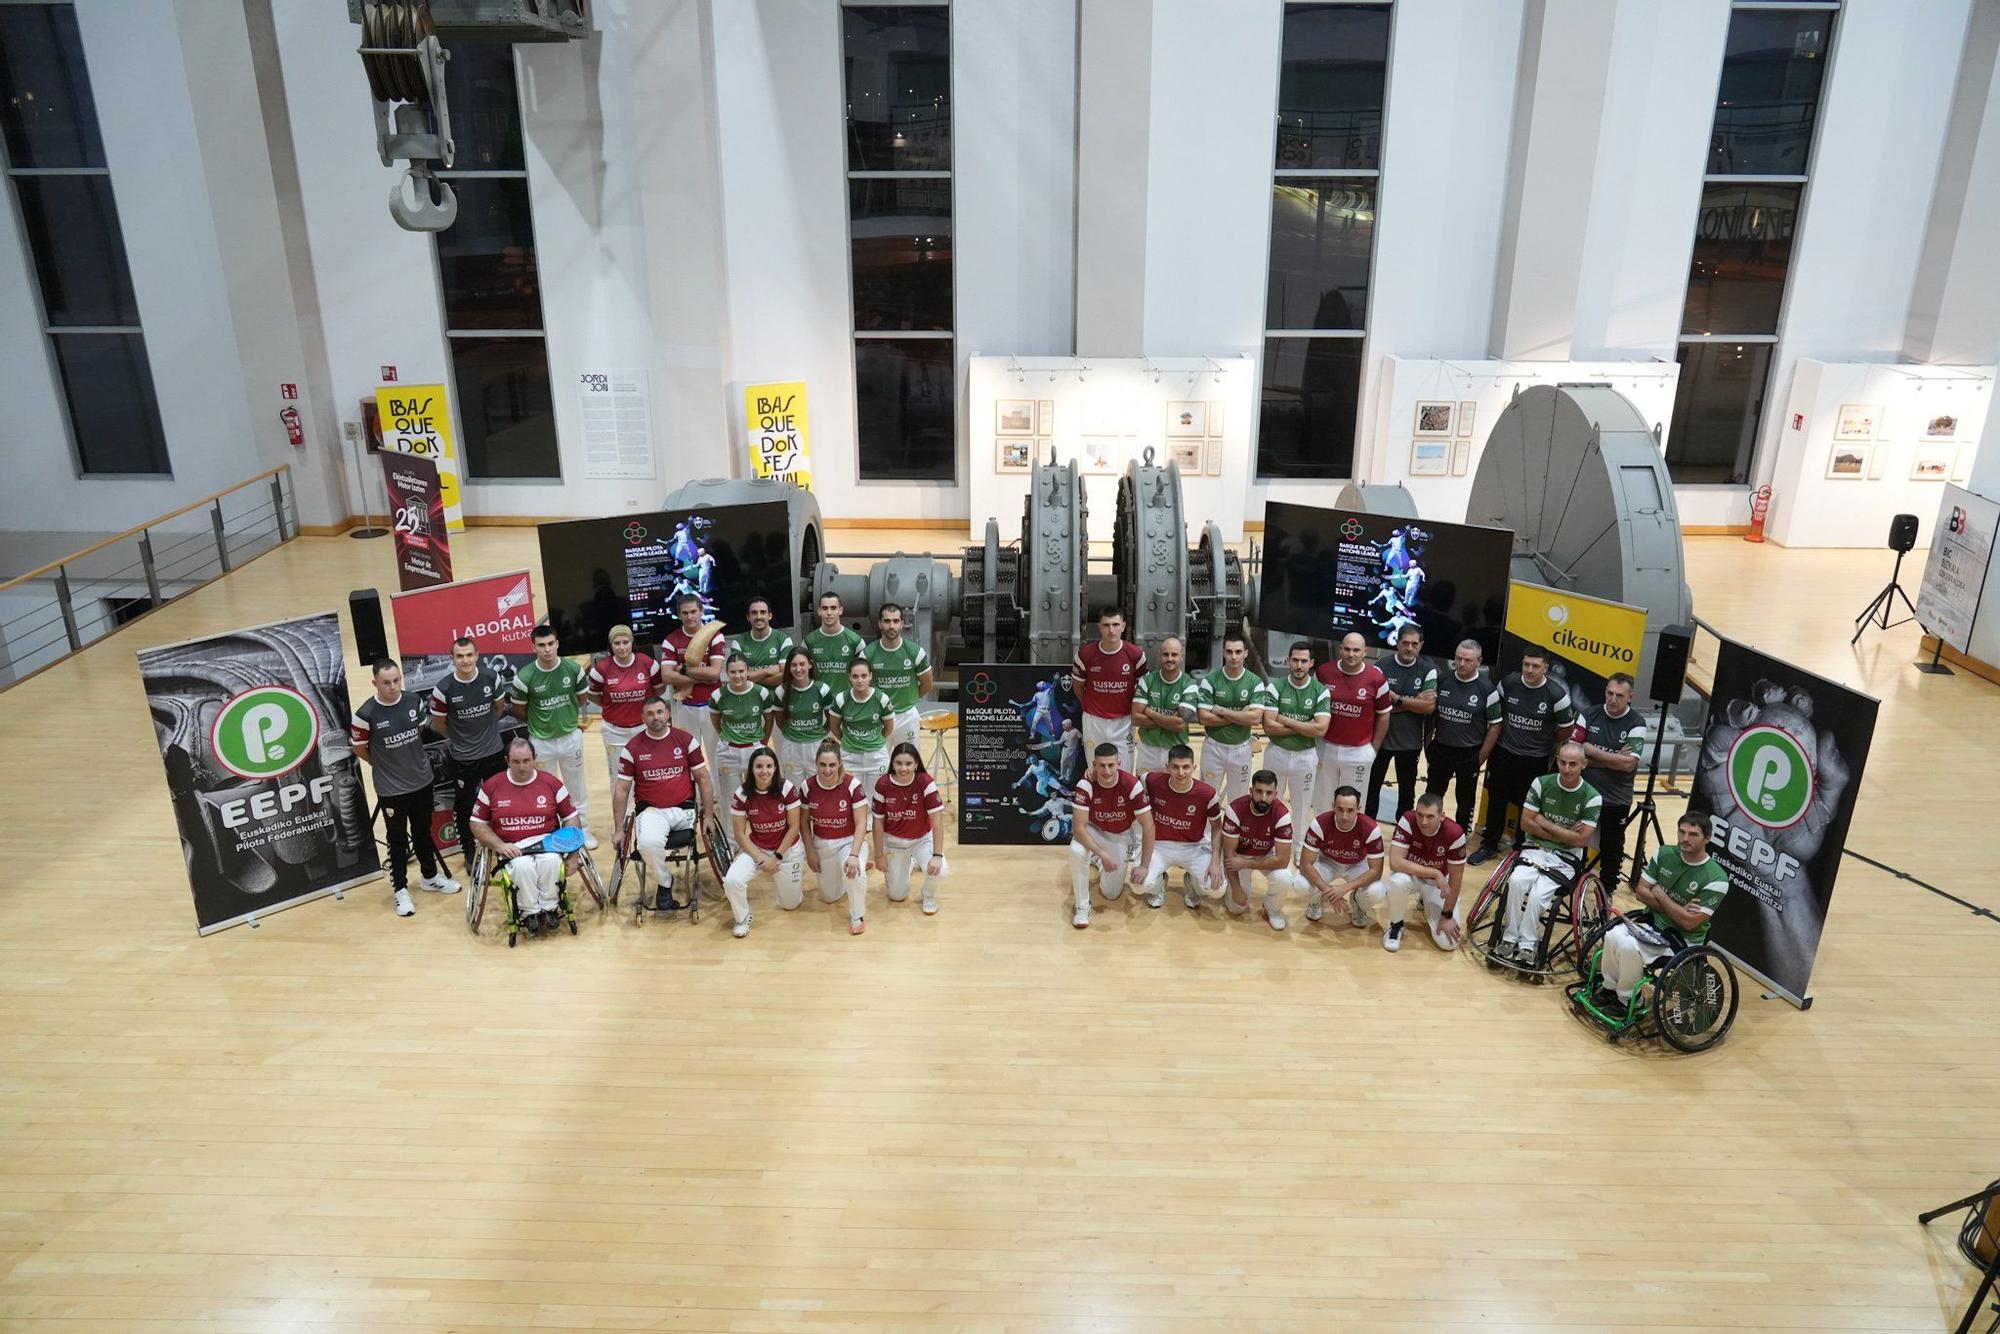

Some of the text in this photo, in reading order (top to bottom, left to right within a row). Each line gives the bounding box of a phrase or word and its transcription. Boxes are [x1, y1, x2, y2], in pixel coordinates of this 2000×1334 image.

[580, 375, 608, 383] JORDI
[389, 398, 433, 416] BAS
[757, 395, 795, 414] BAS
[395, 418, 435, 434] QUE
[761, 415, 795, 432] QUE
[764, 454, 797, 472] FES
[398, 481, 411, 490] Motor
[395, 506, 420, 535] 25
[625, 546, 646, 554] BASQUE
[625, 551, 648, 559] NATIONS
[1943, 547, 1953, 558] BIC
[411, 556, 425, 567] Motor
[1093, 681, 1128, 689] EUSKADI
[1508, 712, 1543, 726] EUSKADI
[384, 727, 419, 744] EUSKADI
[966, 734, 1005, 745] Bilbao
[966, 748, 1027, 759] Barakaldo
[643, 766, 684, 777] EUSKADI
[220, 775, 334, 829] EEPF
[240, 809, 328, 841] Euskadiko Euskal
[500, 816, 546, 826] EUSKADI
[753, 818, 786, 830] EUSKADI
[236, 816, 335, 852] Pilota Federakuntza
[1708, 814, 1800, 882] EEPF
[1711, 852, 1783, 899] Euskadiko Euskal
[1728, 872, 1784, 912] Federakuntza
[1706, 973, 1716, 1005] KEMEN
